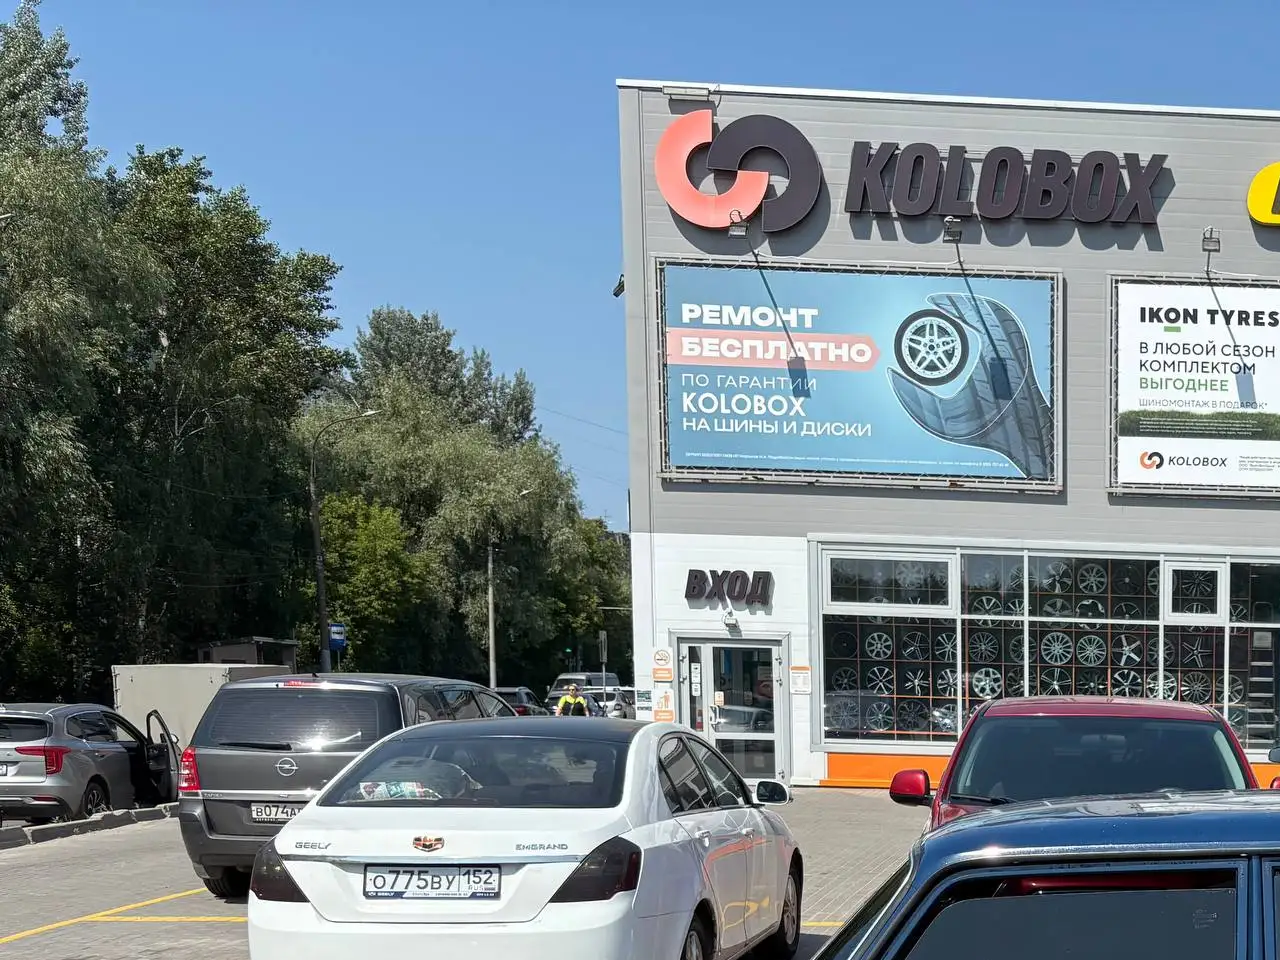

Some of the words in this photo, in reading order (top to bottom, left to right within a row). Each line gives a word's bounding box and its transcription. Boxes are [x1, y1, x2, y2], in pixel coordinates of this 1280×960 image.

[844, 139, 1168, 225] KOLOBOX
[681, 303, 819, 329] РЕМОНТ
[1139, 306, 1199, 325] IKON
[1206, 308, 1280, 327] TYRES
[681, 336, 873, 364] БЕСПЛАТНО
[1139, 342, 1149, 354] В
[1153, 340, 1217, 356] ЛЮБОЙ
[1220, 344, 1276, 358] СЕЗОН
[1139, 359, 1256, 375] КОМПЛЕКТОМ
[681, 373, 710, 388] ПО
[716, 374, 817, 391] ГАРАНТИИ
[1139, 377, 1229, 393] ВЫГОДНЕЕ
[682, 392, 807, 417] KOLOBOX
[1138, 399, 1210, 409] ШИНОМОНТАЖ
[682, 417, 712, 432] НА
[714, 418, 779, 435] ШИНЫ
[783, 420, 797, 435] И
[800, 421, 873, 437] ДИСКИ
[1168, 456, 1228, 468] KOLOBOX
[684, 569, 774, 606] ВХОД
[294, 841, 332, 850] GEELY
[462, 869, 493, 885] 152
